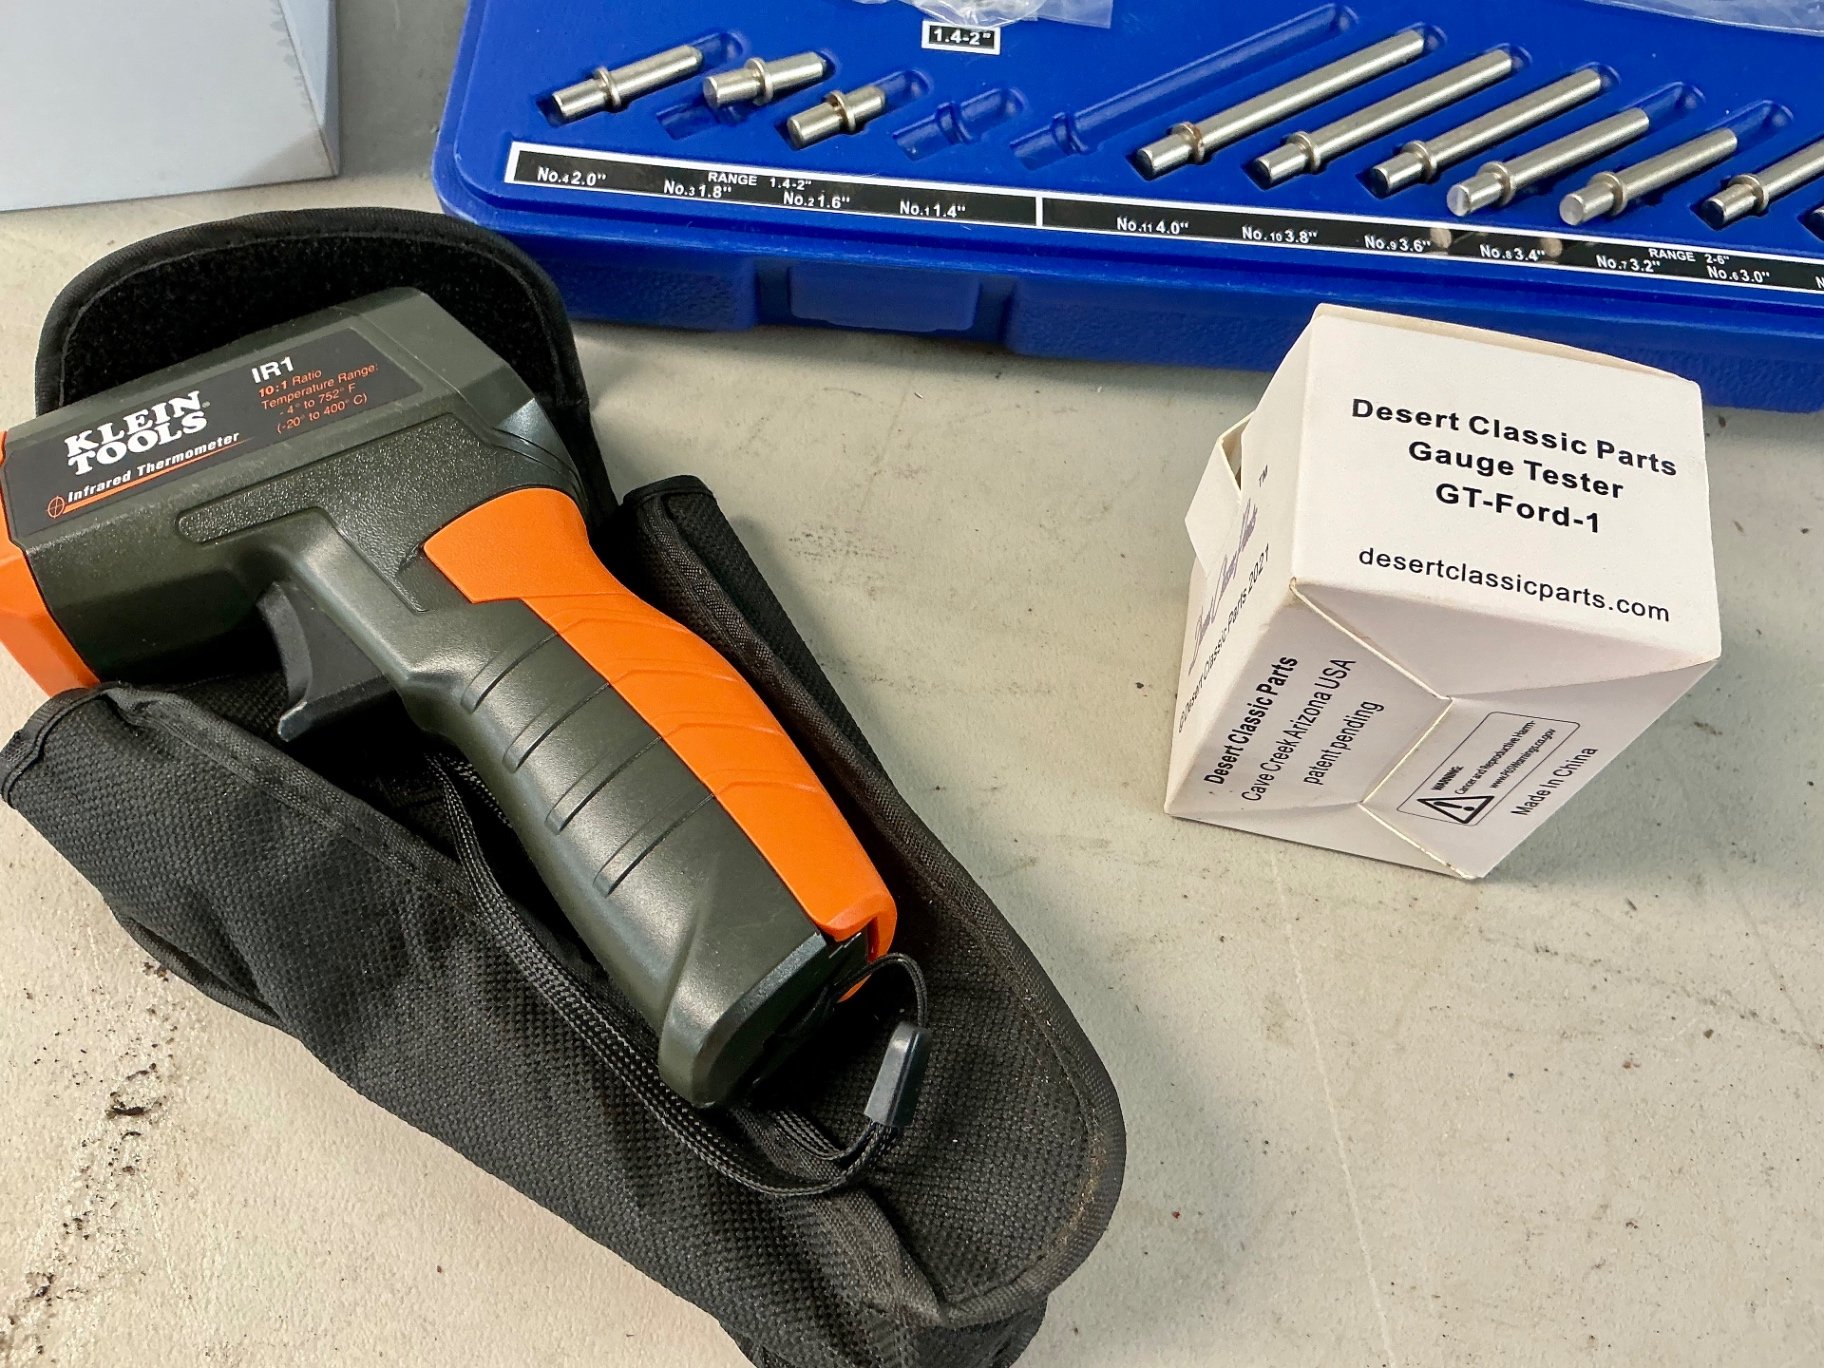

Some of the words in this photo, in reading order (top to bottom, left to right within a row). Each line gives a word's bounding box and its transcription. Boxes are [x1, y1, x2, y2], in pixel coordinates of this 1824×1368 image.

[708, 172, 758, 186] RANGE
[1649, 248, 1696, 262] RANGE
[252, 356, 294, 384] IR1
[259, 380, 288, 397] 10:1
[292, 370, 322, 386] Ratio
[262, 378, 334, 410] Temperature
[338, 364, 378, 383] Range:
[304, 399, 315, 409] to
[348, 383, 356, 393] F
[64, 390, 200, 457] KLEIN
[309, 412, 320, 421] to
[353, 393, 367, 405] C)
[67, 411, 207, 475] TOOLS
[1351, 398, 1459, 431] Desert
[1468, 415, 1587, 454] Classic
[1597, 440, 1677, 476] Parts
[67, 470, 131, 502] Infrared
[137, 432, 239, 477] Thermometer
[1408, 441, 1514, 478] Gauge
[1524, 460, 1624, 499] Tester
[1436, 483, 1599, 533] GT-Ford-1
[1247, 542, 1268, 594] 2021
[1359, 548, 1670, 622] desertclassicparts.com
[1204, 745, 1244, 785] Desert
[1228, 696, 1273, 745] Classic
[1256, 656, 1298, 695] Parts
[1241, 772, 1274, 801] Cave
[1260, 738, 1299, 772] Creek
[1283, 691, 1332, 740] Arizona
[1314, 659, 1356, 690] USA
[1303, 749, 1342, 785] patent
[1330, 701, 1384, 751] pending
[1454, 779, 1477, 794] Cancer
[1472, 768, 1487, 779] and
[1480, 737, 1520, 770] Reproductive
[1510, 790, 1551, 815] Made
[1539, 779, 1564, 788] In
[1553, 748, 1598, 777] China
